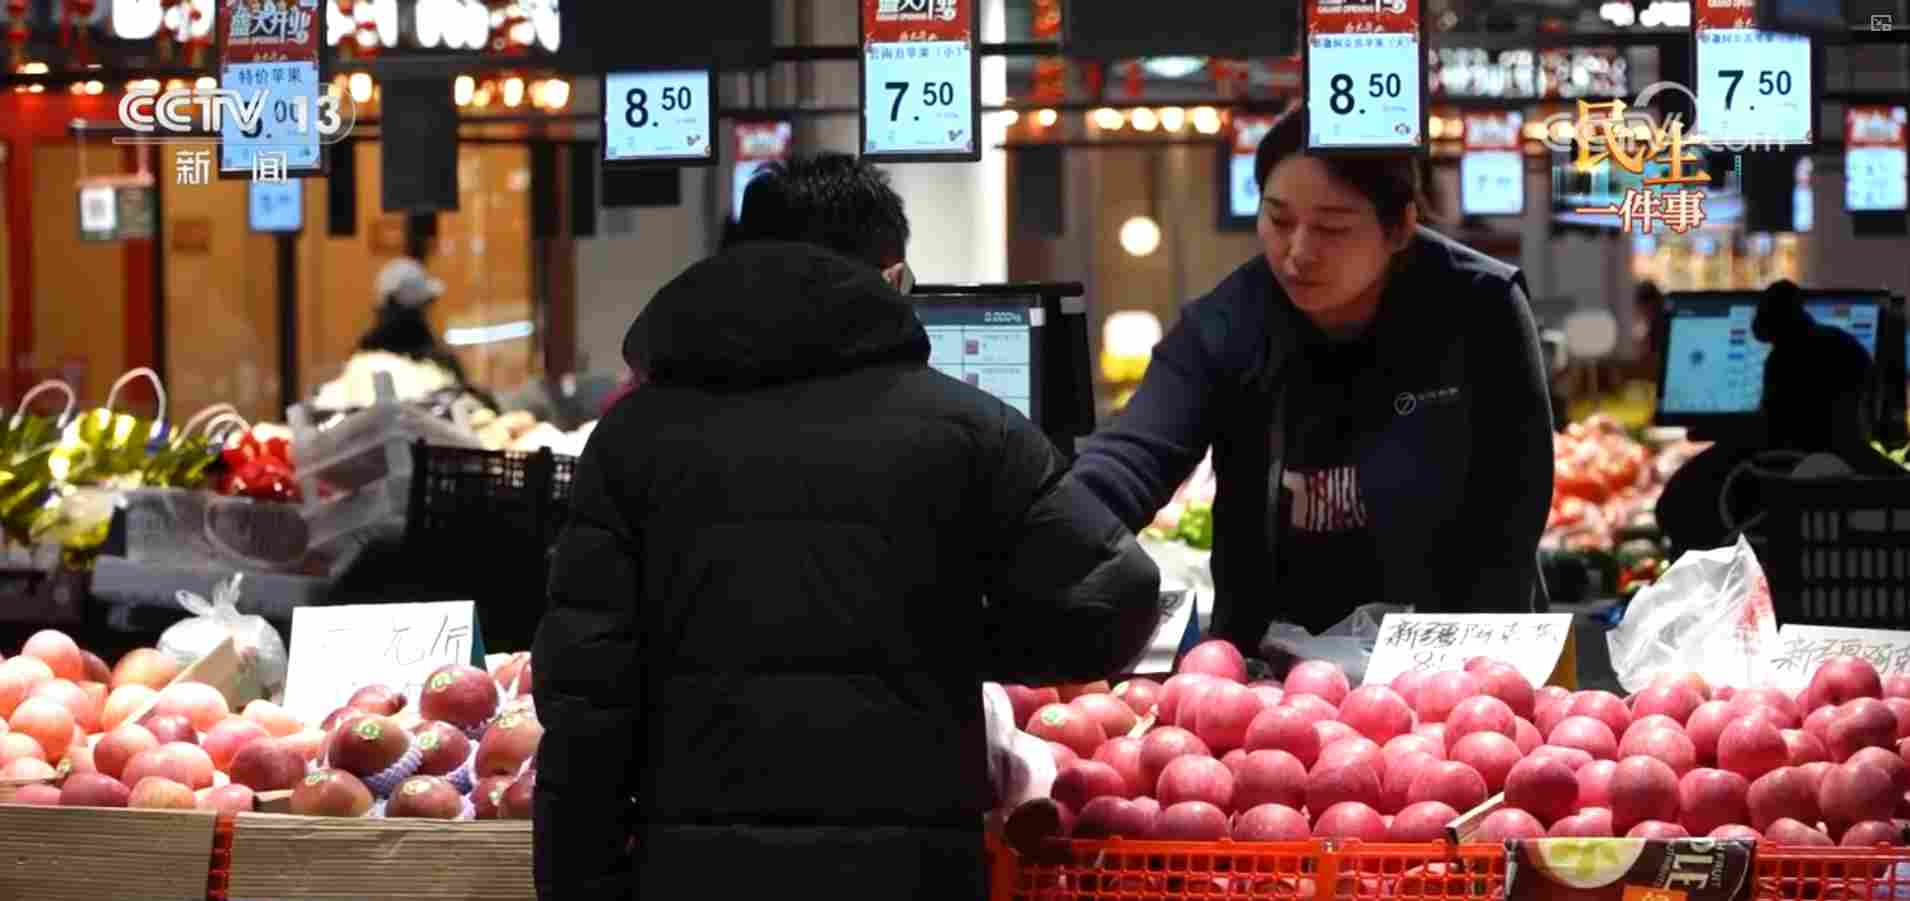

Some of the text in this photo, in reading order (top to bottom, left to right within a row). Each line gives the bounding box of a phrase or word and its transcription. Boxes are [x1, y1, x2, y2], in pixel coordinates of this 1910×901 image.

[238, 67, 303, 84] 特价苹果
[1329, 73, 1401, 115] 8.50
[1717, 70, 1792, 111] 7.50
[625, 86, 691, 128] 8.50
[884, 81, 954, 122] 7.50
